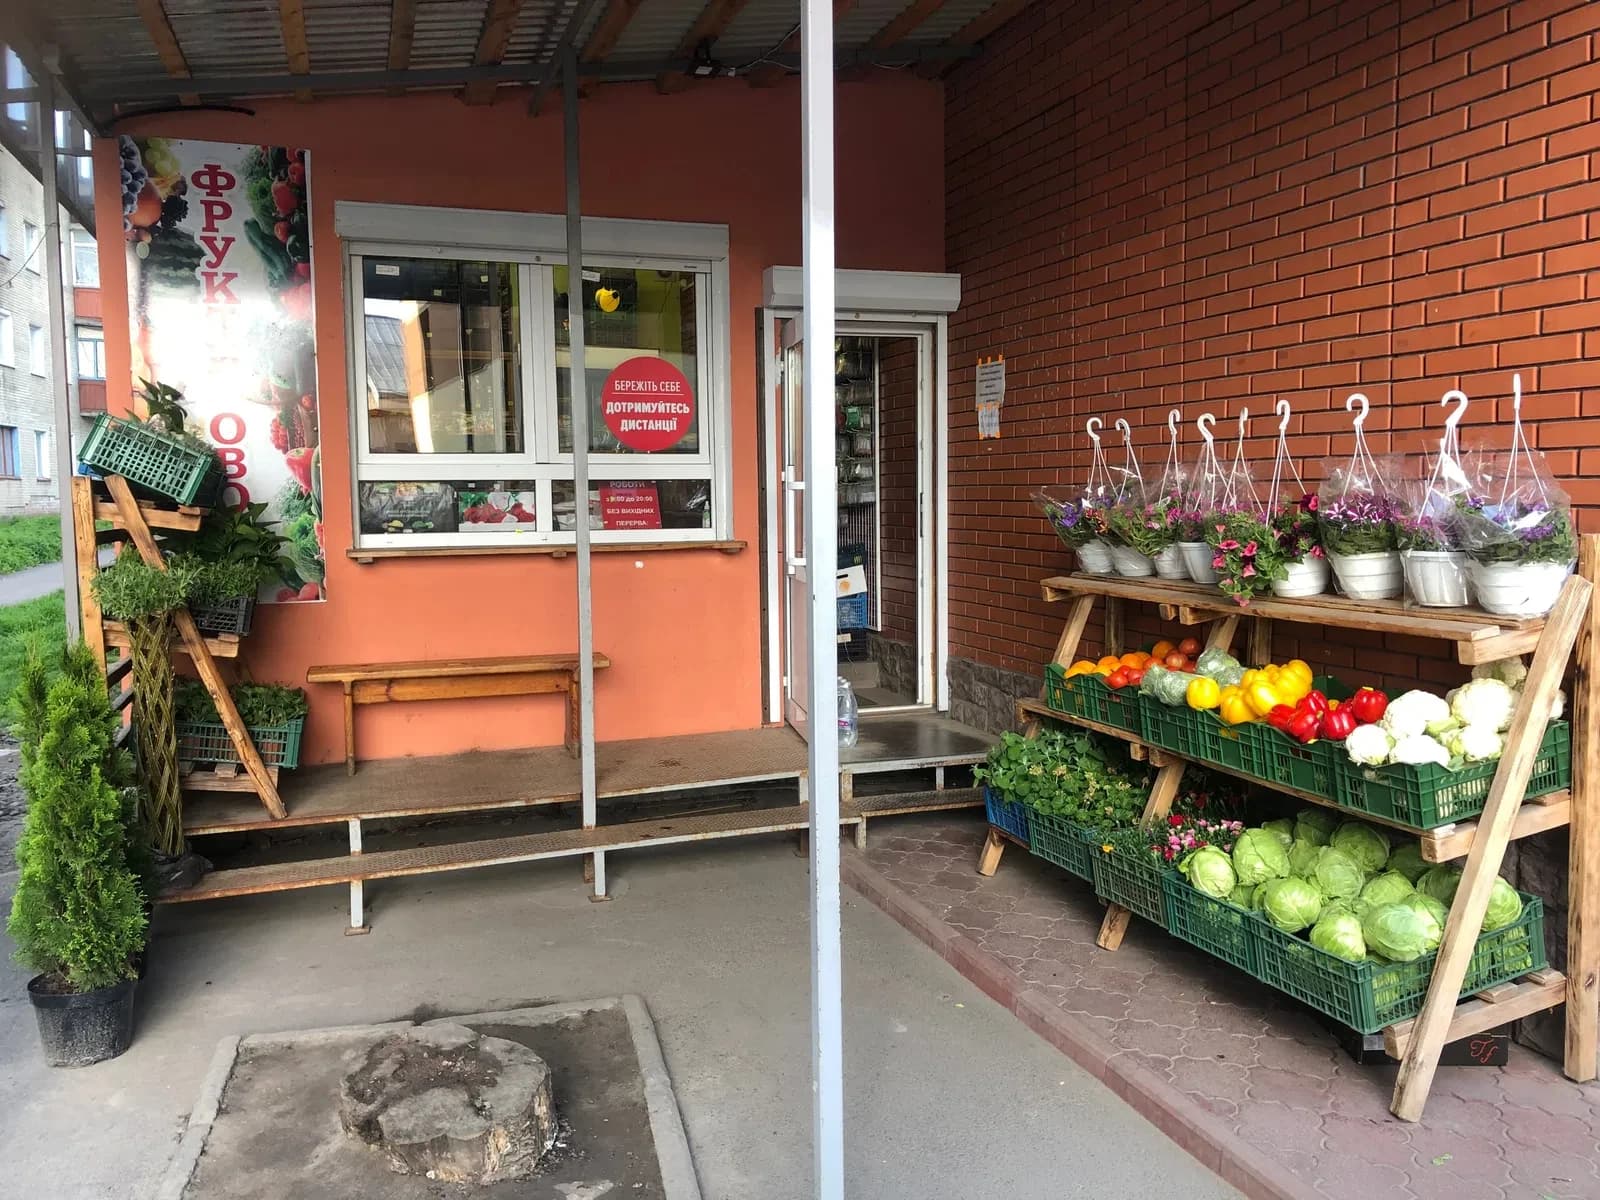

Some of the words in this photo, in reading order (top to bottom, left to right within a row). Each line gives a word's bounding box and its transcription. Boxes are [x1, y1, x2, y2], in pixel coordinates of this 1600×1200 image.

[614, 380, 658, 392] БЕРЕЖІТЬ
[659, 381, 681, 392] СЕБЕ
[605, 400, 690, 414] ДОТРИМУЙТЕСЬ
[620, 417, 678, 432] ДИСТАНЦІЇ
